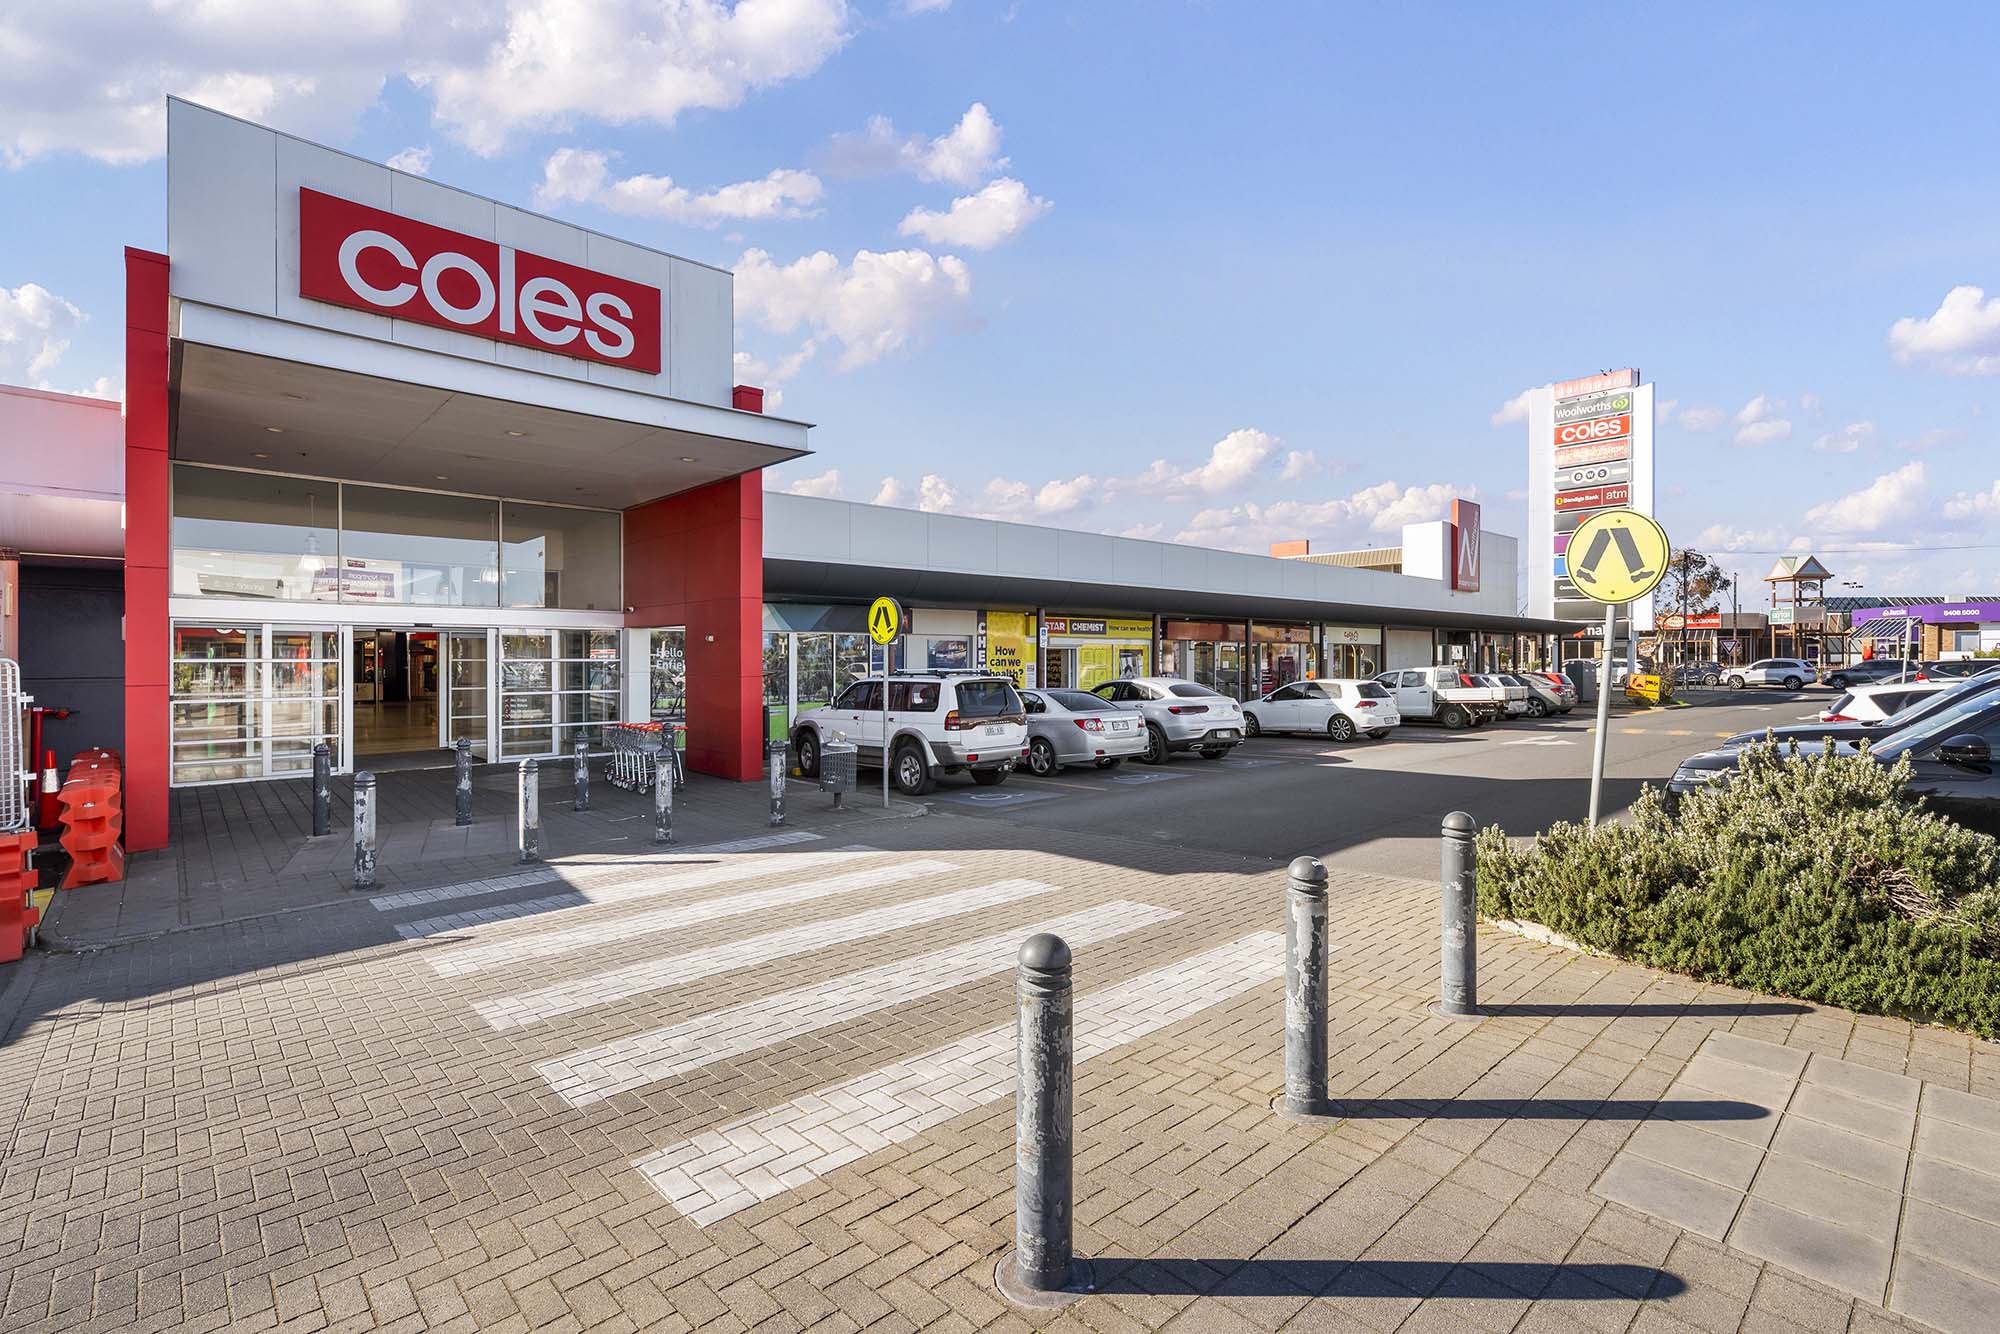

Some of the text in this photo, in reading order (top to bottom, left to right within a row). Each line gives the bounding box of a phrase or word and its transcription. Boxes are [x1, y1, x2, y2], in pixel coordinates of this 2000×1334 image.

[338, 229, 635, 358] coles
[1556, 401, 1611, 418] Woolworths
[1561, 420, 1621, 441] coles
[1606, 490, 1627, 499] atm
[1045, 621, 1104, 632] STAR CHEMIST
[656, 647, 684, 658] Hello
[995, 646, 1016, 656] How
[990, 658, 1021, 667] can we
[990, 668, 1024, 679] health?
